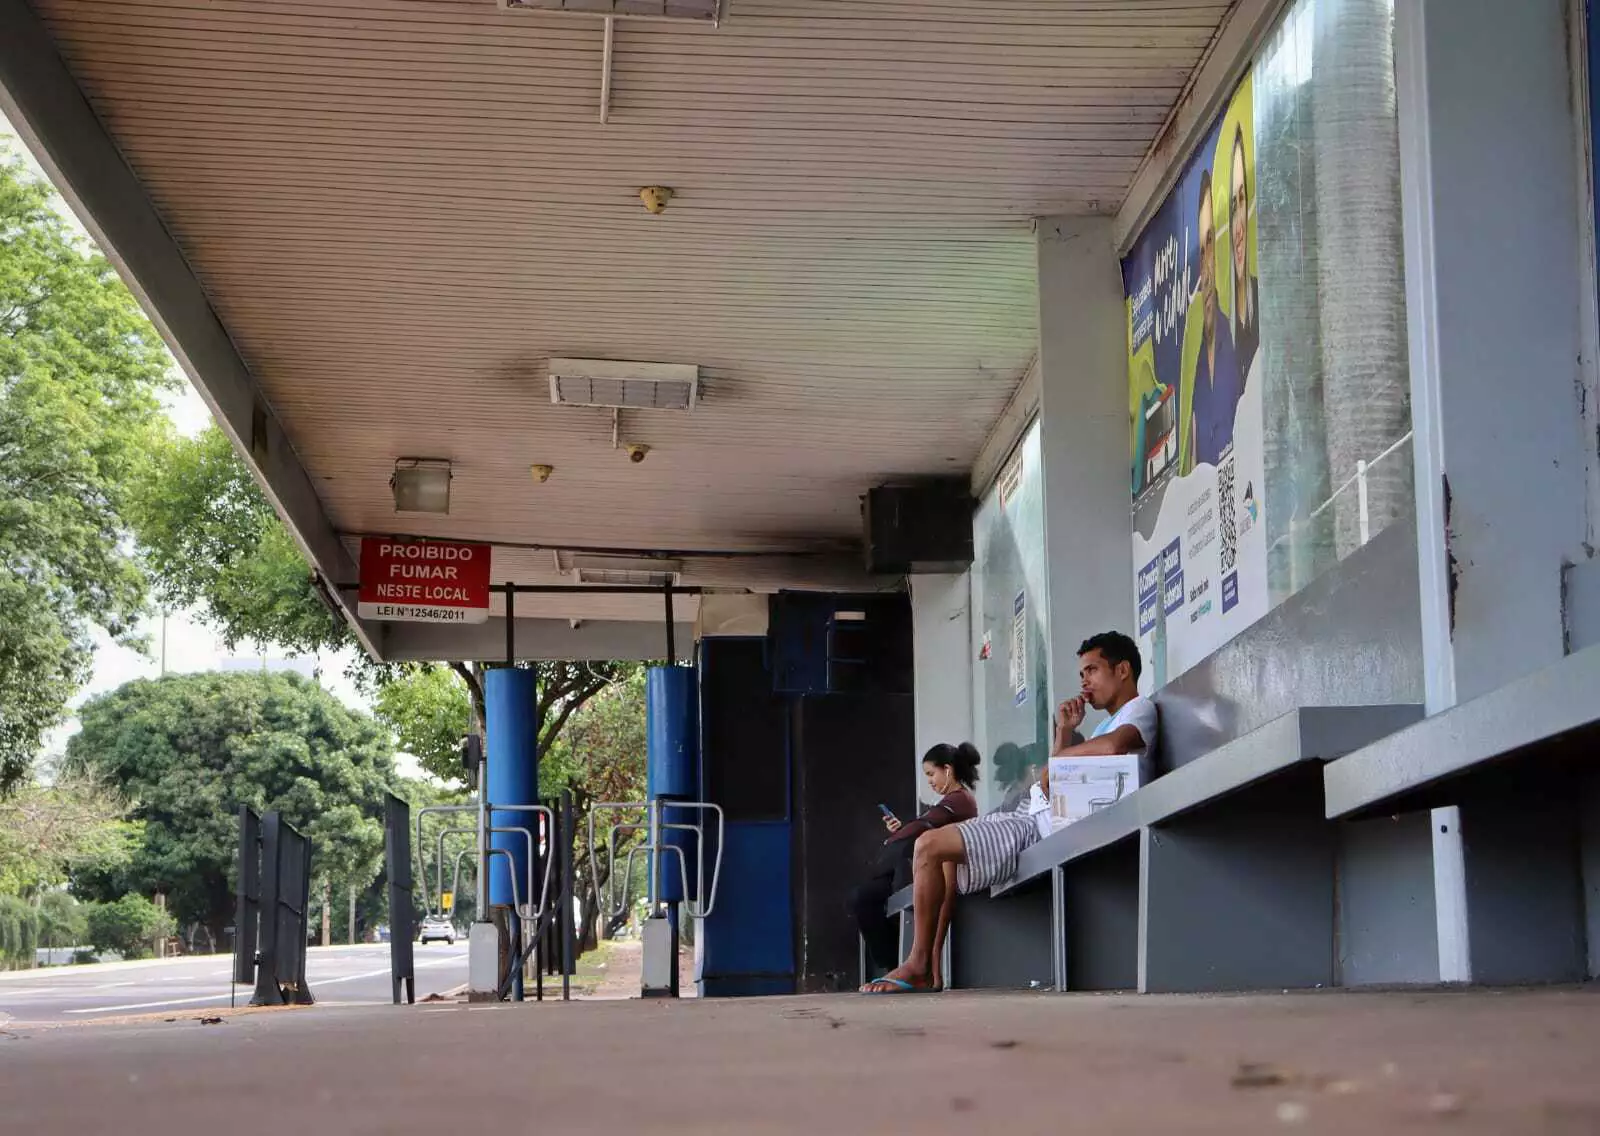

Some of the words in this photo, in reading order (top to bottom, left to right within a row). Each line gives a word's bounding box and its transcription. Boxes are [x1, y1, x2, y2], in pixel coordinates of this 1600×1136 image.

[379, 544, 473, 561] PROIBIDO
[389, 564, 458, 580] FUMAR
[377, 583, 421, 599] NESTE
[425, 585, 470, 601] LOCAL
[377, 605, 394, 616] LEI
